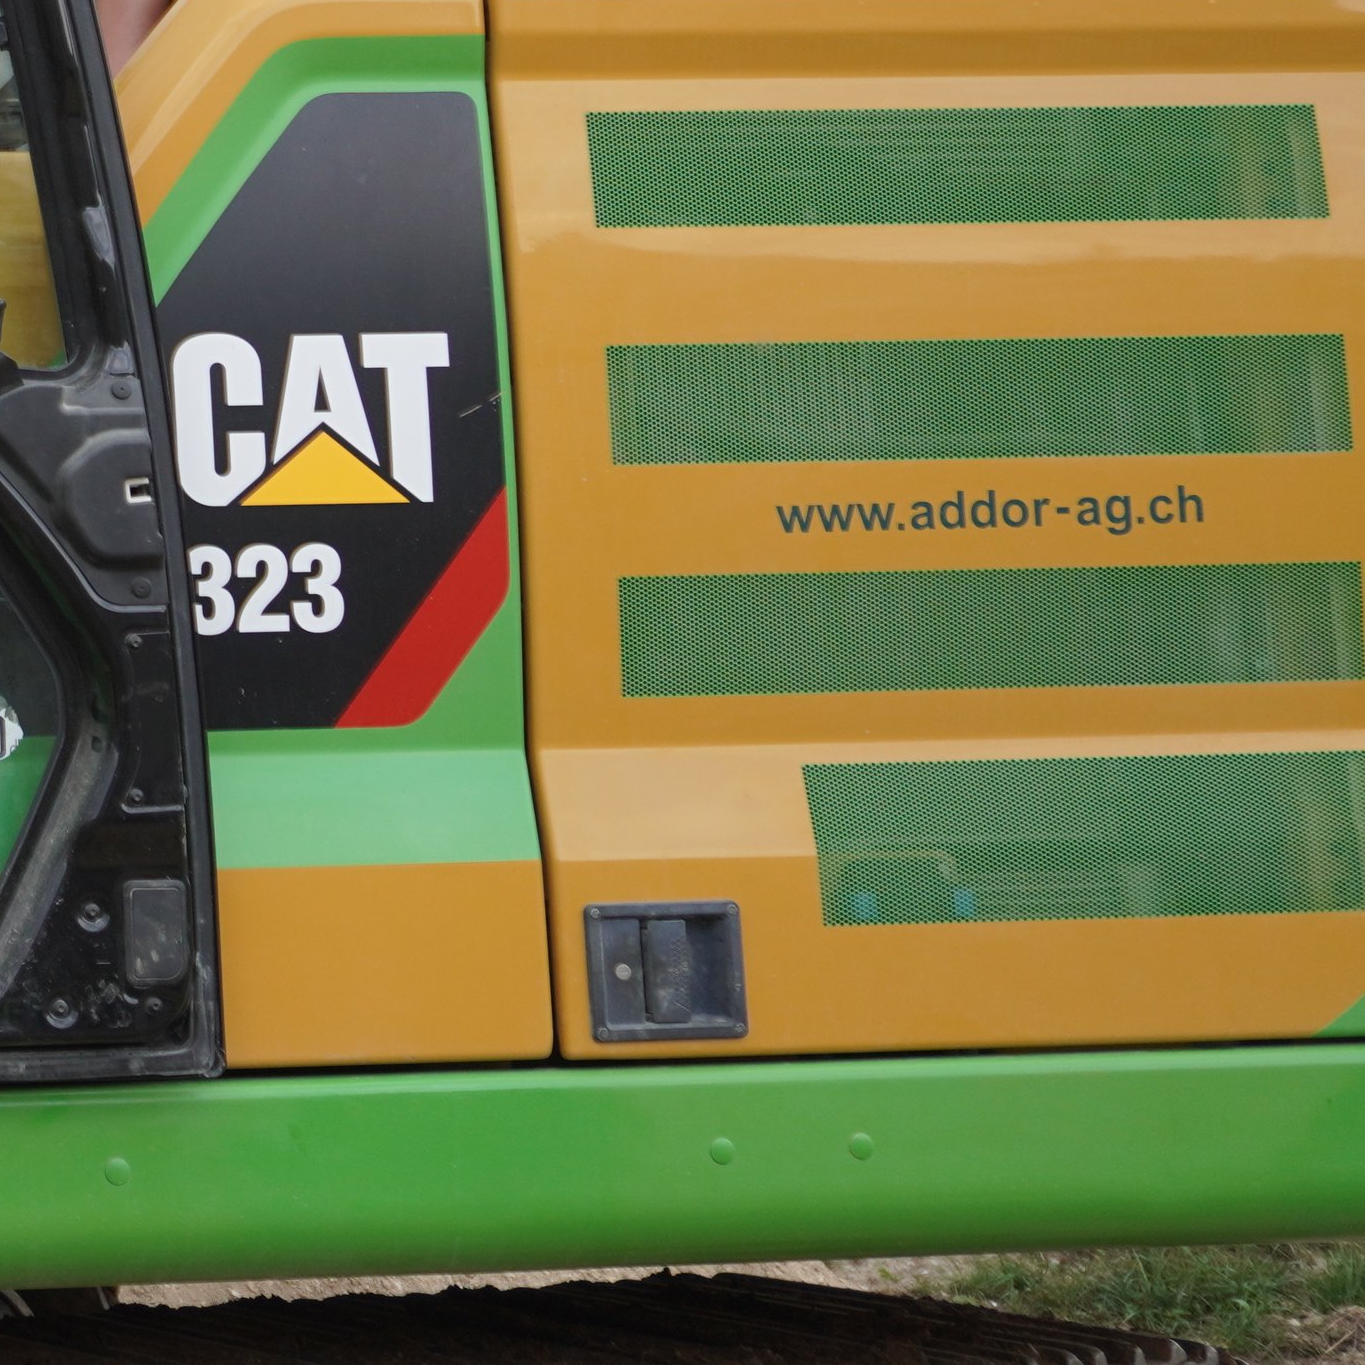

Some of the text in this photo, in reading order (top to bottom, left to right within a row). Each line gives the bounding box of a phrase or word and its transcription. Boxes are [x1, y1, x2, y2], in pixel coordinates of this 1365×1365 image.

[172, 331, 450, 506] CAT
[776, 484, 1205, 535] www.addor-ag.ch
[187, 541, 345, 636] 323
